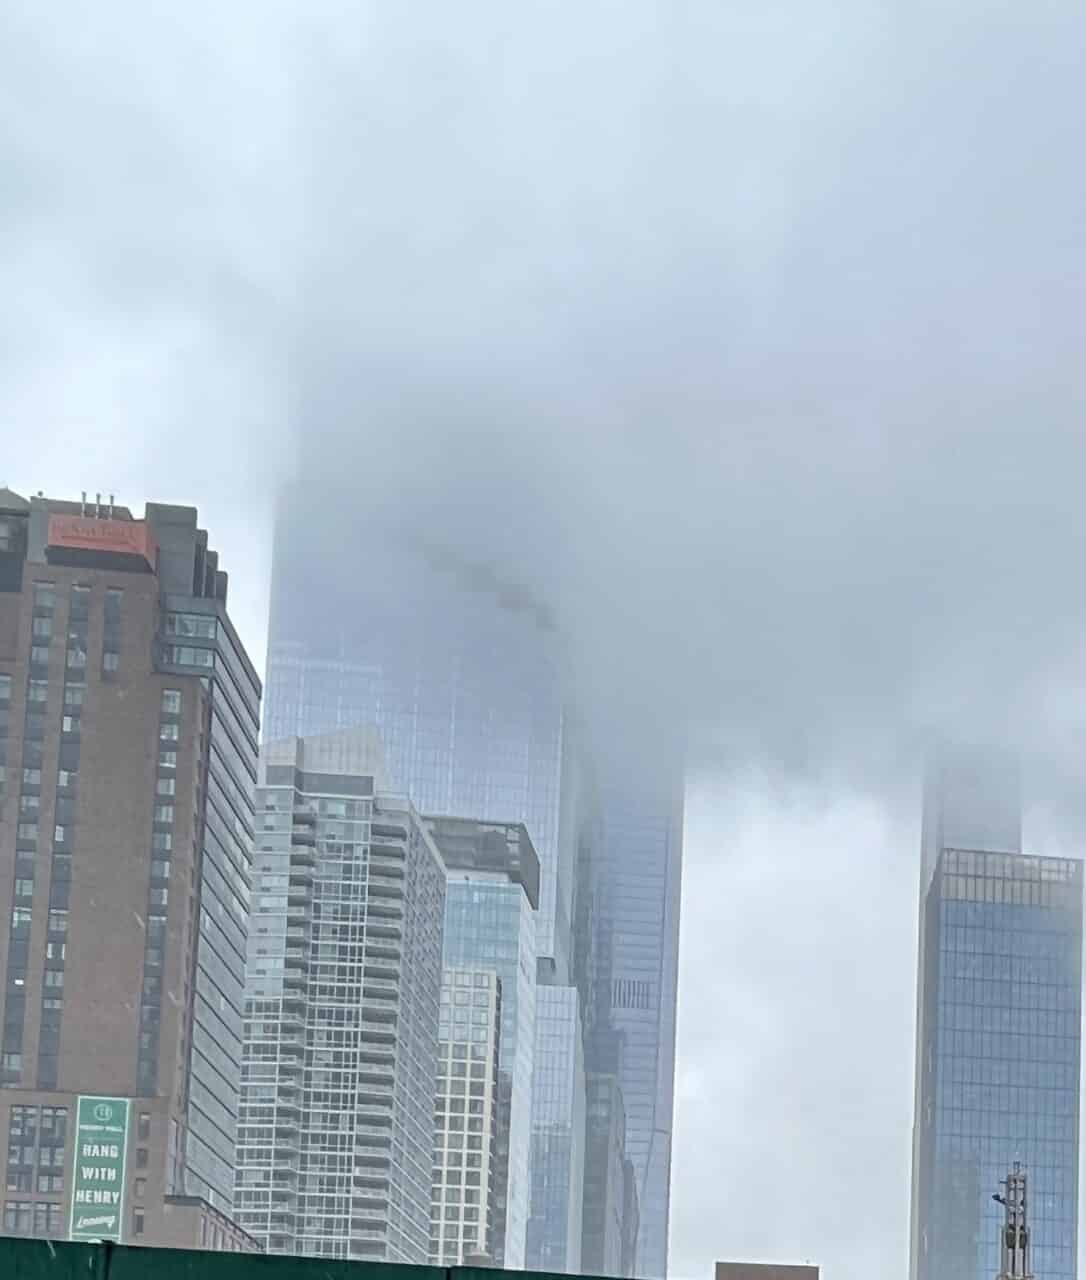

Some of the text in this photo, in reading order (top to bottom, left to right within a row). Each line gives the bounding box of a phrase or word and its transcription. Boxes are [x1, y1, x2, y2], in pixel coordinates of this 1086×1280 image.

[82, 1143, 119, 1158] HANG
[81, 1166, 117, 1181] WITH
[76, 1189, 120, 1205] HENRY
